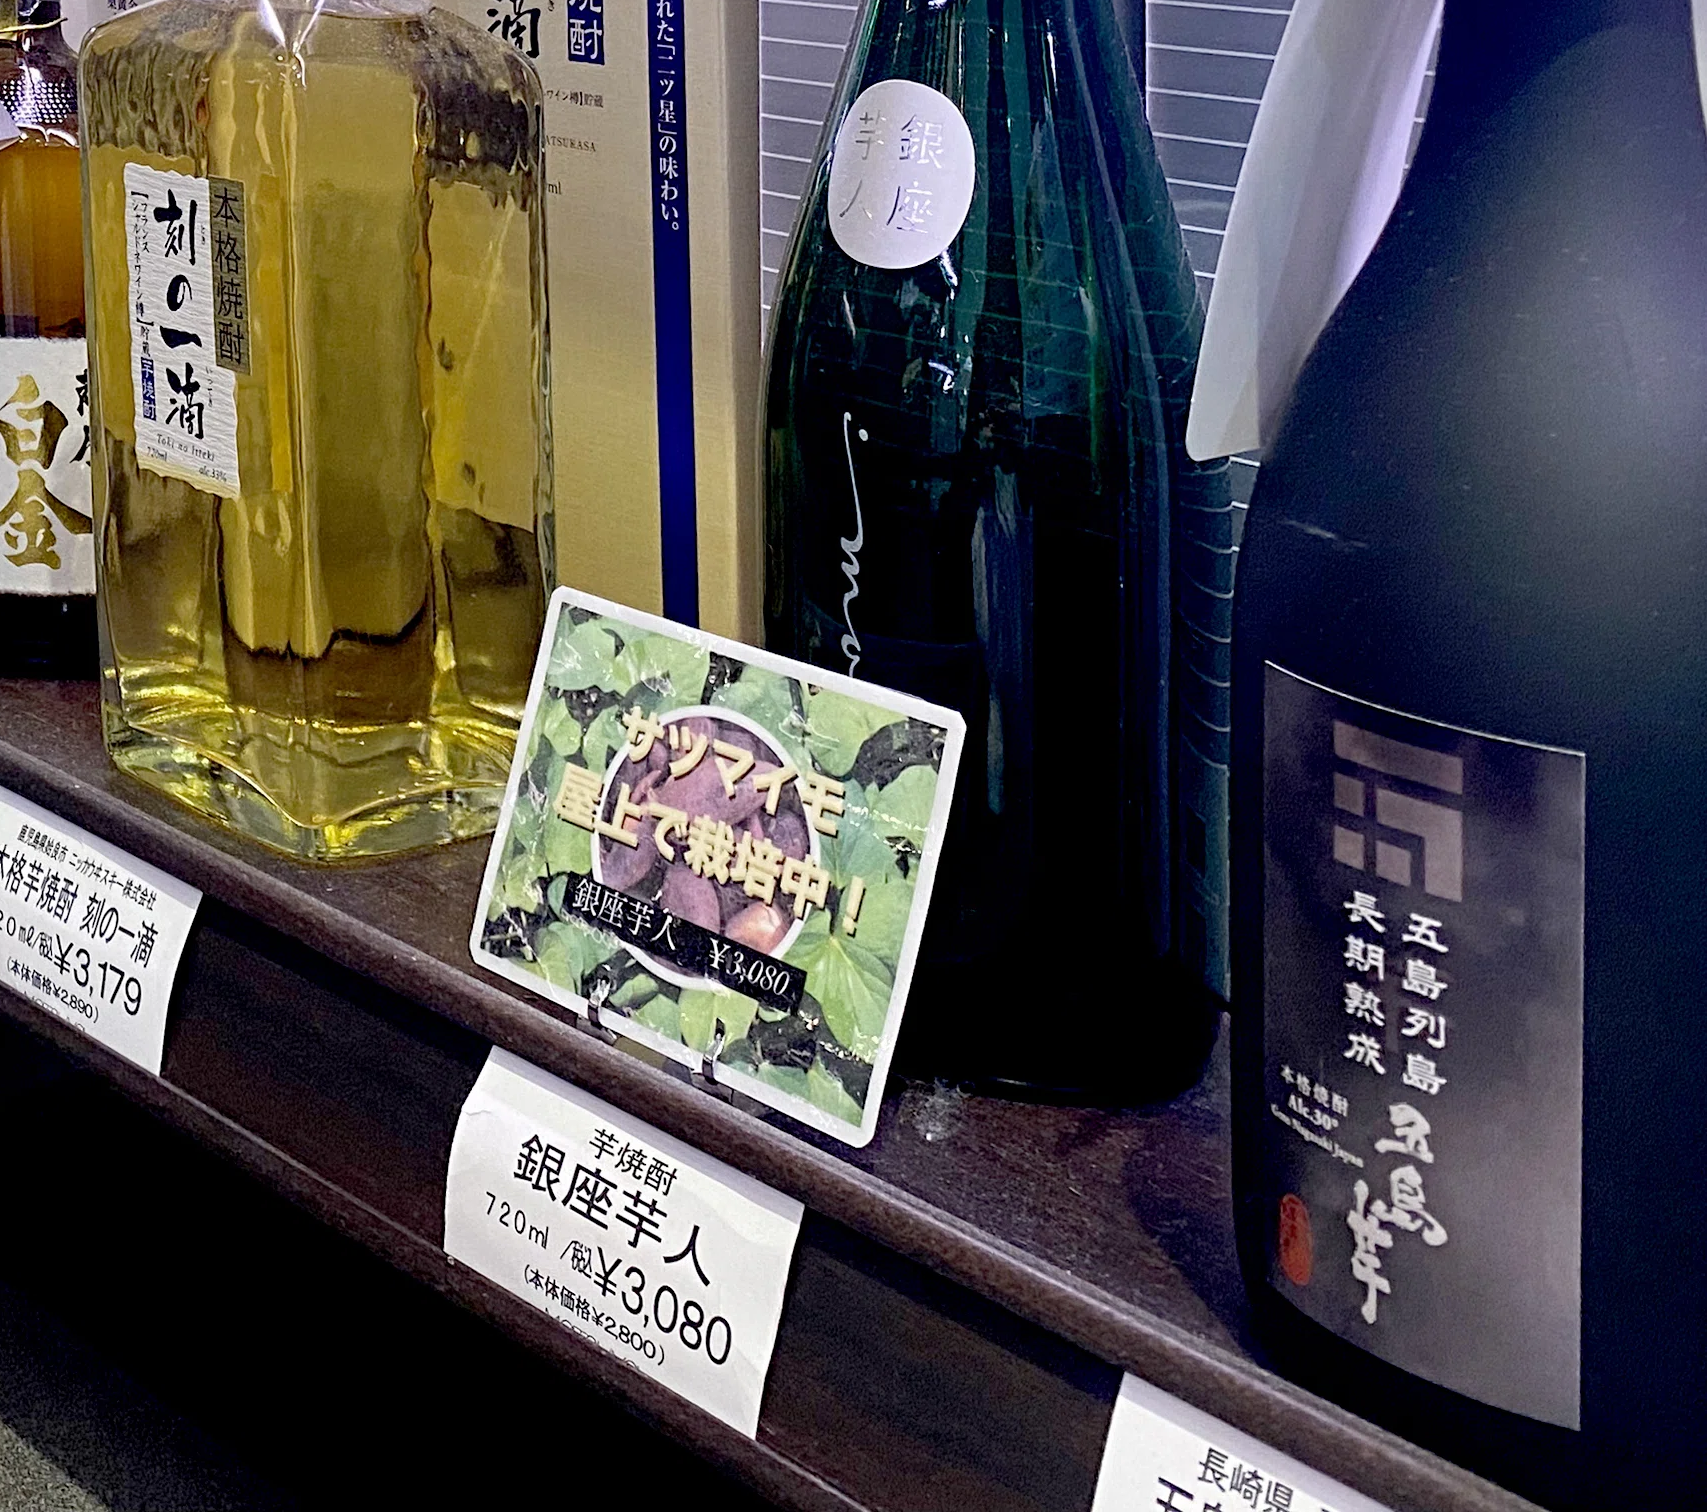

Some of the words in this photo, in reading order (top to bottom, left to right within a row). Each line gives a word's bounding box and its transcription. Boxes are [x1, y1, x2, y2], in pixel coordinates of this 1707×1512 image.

[153, 188, 205, 441] 刻の一滴
[213, 186, 245, 367] 本格焼酎
[623, 705, 848, 838] サツマイモ
[553, 762, 867, 937] 屋上で栽培中！
[79, 891, 159, 968] 刻の一滴
[570, 874, 680, 952] 銀座芋人
[708, 936, 792, 997] ¥3,080
[1343, 889, 1387, 1076] 長期熟成
[1401, 912, 1449, 1095] 五島列島
[589, 1128, 678, 1196] 芋焼酎
[1280, 1064, 1349, 1118] 本格焼酎
[485, 1191, 549, 1250] 720ml
[513, 1134, 711, 1287] 銀座芋人
